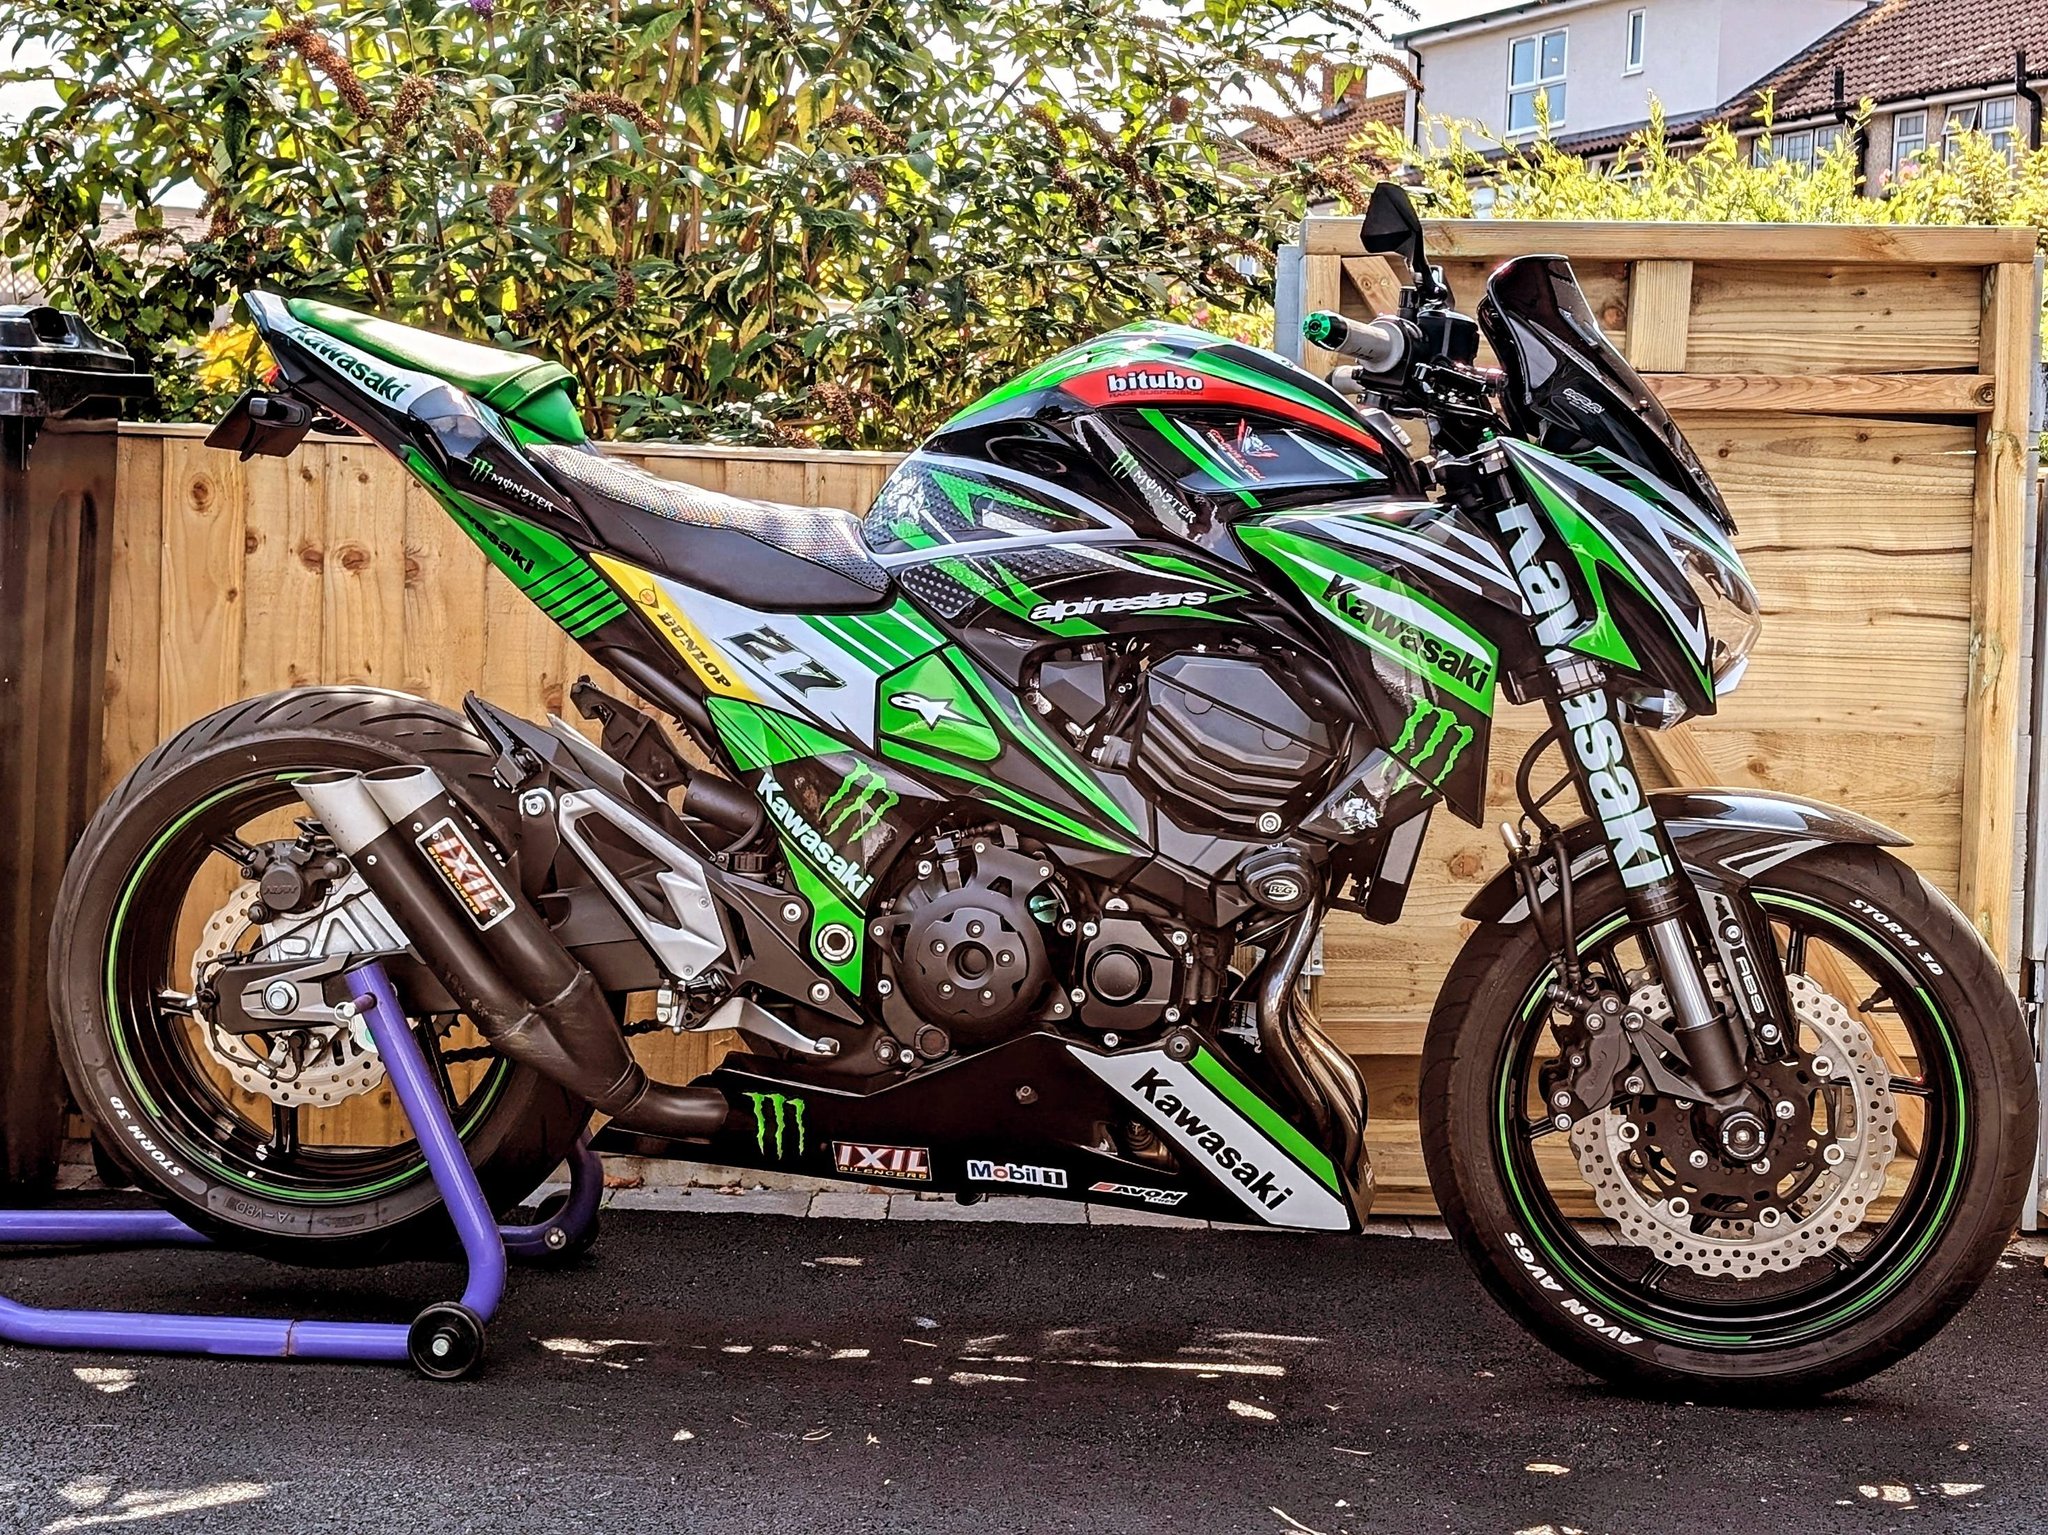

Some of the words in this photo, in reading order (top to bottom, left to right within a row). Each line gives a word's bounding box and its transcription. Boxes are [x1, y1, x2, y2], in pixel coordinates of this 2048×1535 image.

[286, 326, 412, 402] Kawasaki
[1107, 370, 1205, 392] bitubo
[1030, 591, 1207, 622] alpinestars
[1322, 574, 1491, 694] Kawasaki
[657, 612, 732, 688] DUNLOP
[723, 623, 848, 699] 27
[757, 772, 875, 900] Kawasaki
[427, 846, 480, 915] SILENCERS
[431, 836, 500, 912] IXIL
[1849, 899, 1920, 947] STORM
[1917, 951, 1944, 975] 3D
[1735, 956, 1765, 1014] ABS
[109, 1096, 132, 1120] 3D
[127, 1125, 184, 1177] STORM
[838, 1144, 930, 1173] IXIL
[1130, 1066, 1294, 1210] Kawasaki
[839, 1164, 930, 1180] SILENCERS
[969, 1160, 1038, 1184] Mobil
[1044, 1171, 1064, 1187] 1
[1115, 1185, 1184, 1200] AVON
[1504, 1232, 1564, 1292] AV65
[1560, 1298, 1644, 1345] AVON
